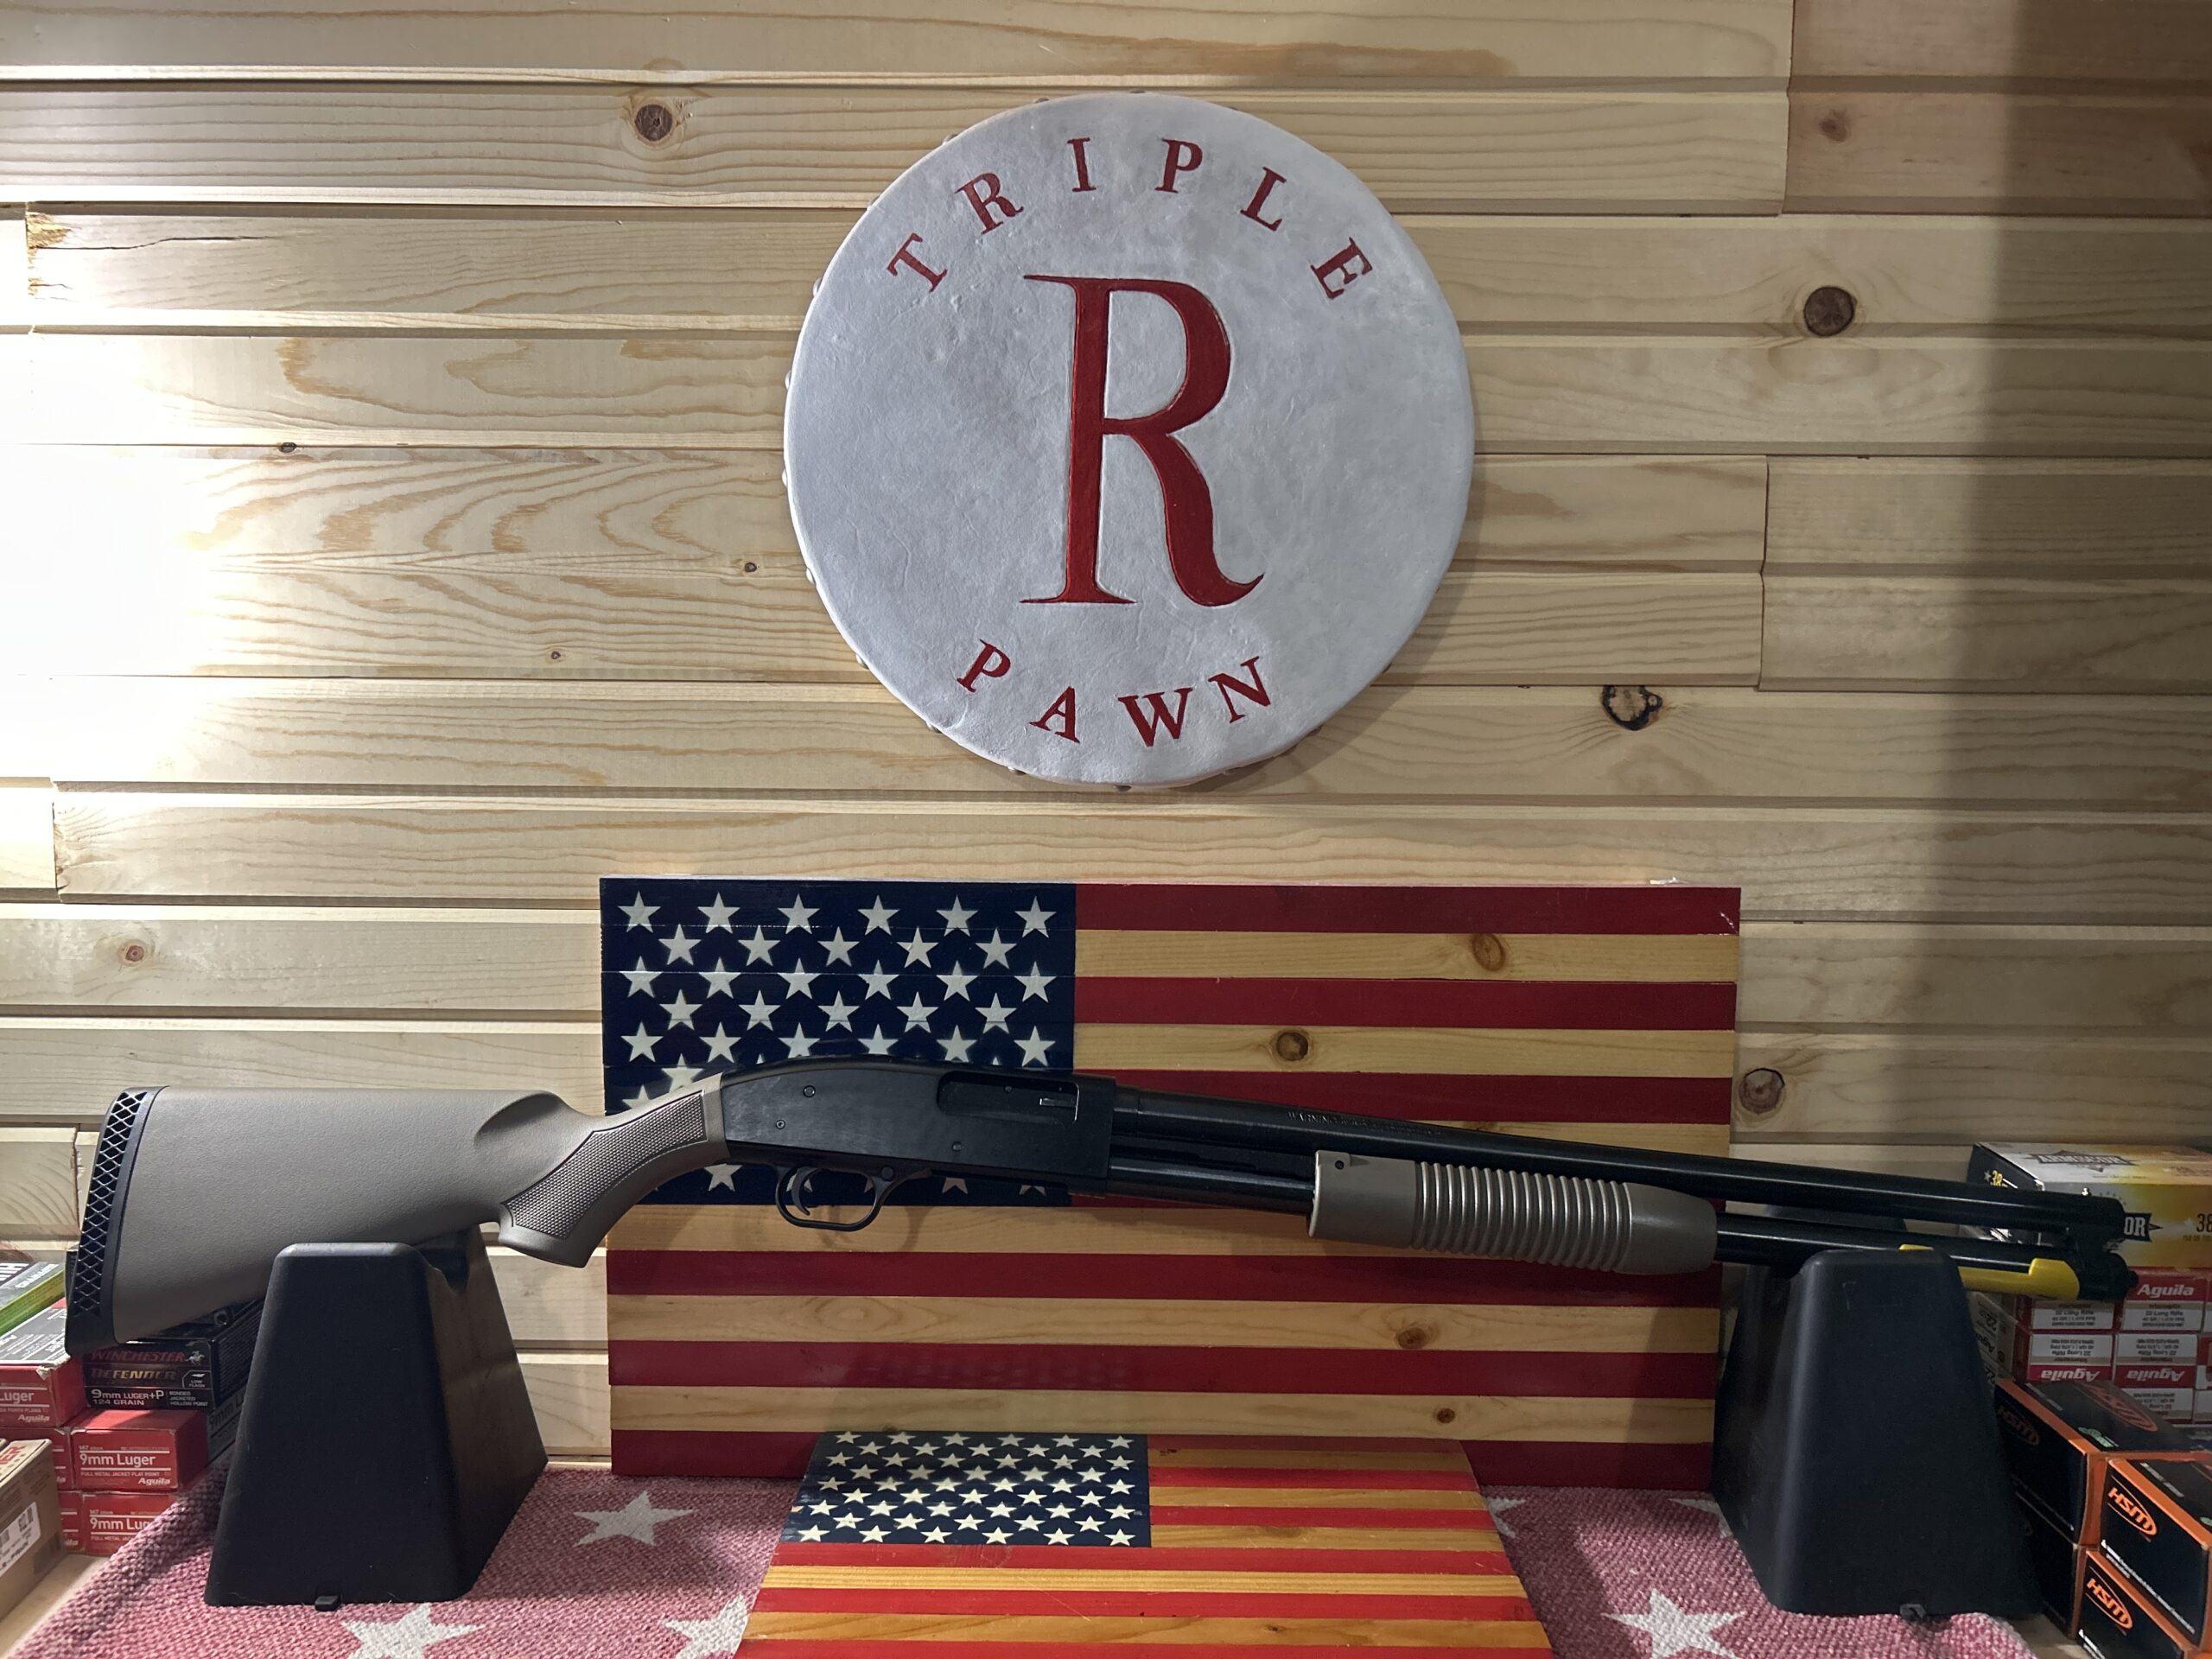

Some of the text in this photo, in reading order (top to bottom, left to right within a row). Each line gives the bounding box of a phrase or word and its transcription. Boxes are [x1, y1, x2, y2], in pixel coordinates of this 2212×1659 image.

[886, 137, 1374, 301] TRIPLE
[1020, 274, 1265, 607] R
[957, 639, 1273, 748] PAWN
[2137, 1284, 2195, 1298] Aguila
[91, 1350, 185, 1363] WINCHESTER
[90, 1368, 177, 1380] DEFENDER
[2041, 1368, 2101, 1382] Aguila
[2126, 1369, 2185, 1382] Aguila
[91, 1389, 121, 1399] 9mm
[79, 1453, 156, 1468] 9mm Luger
[138, 1478, 170, 1486] Aguila
[89, 1517, 124, 1529] 9mm
